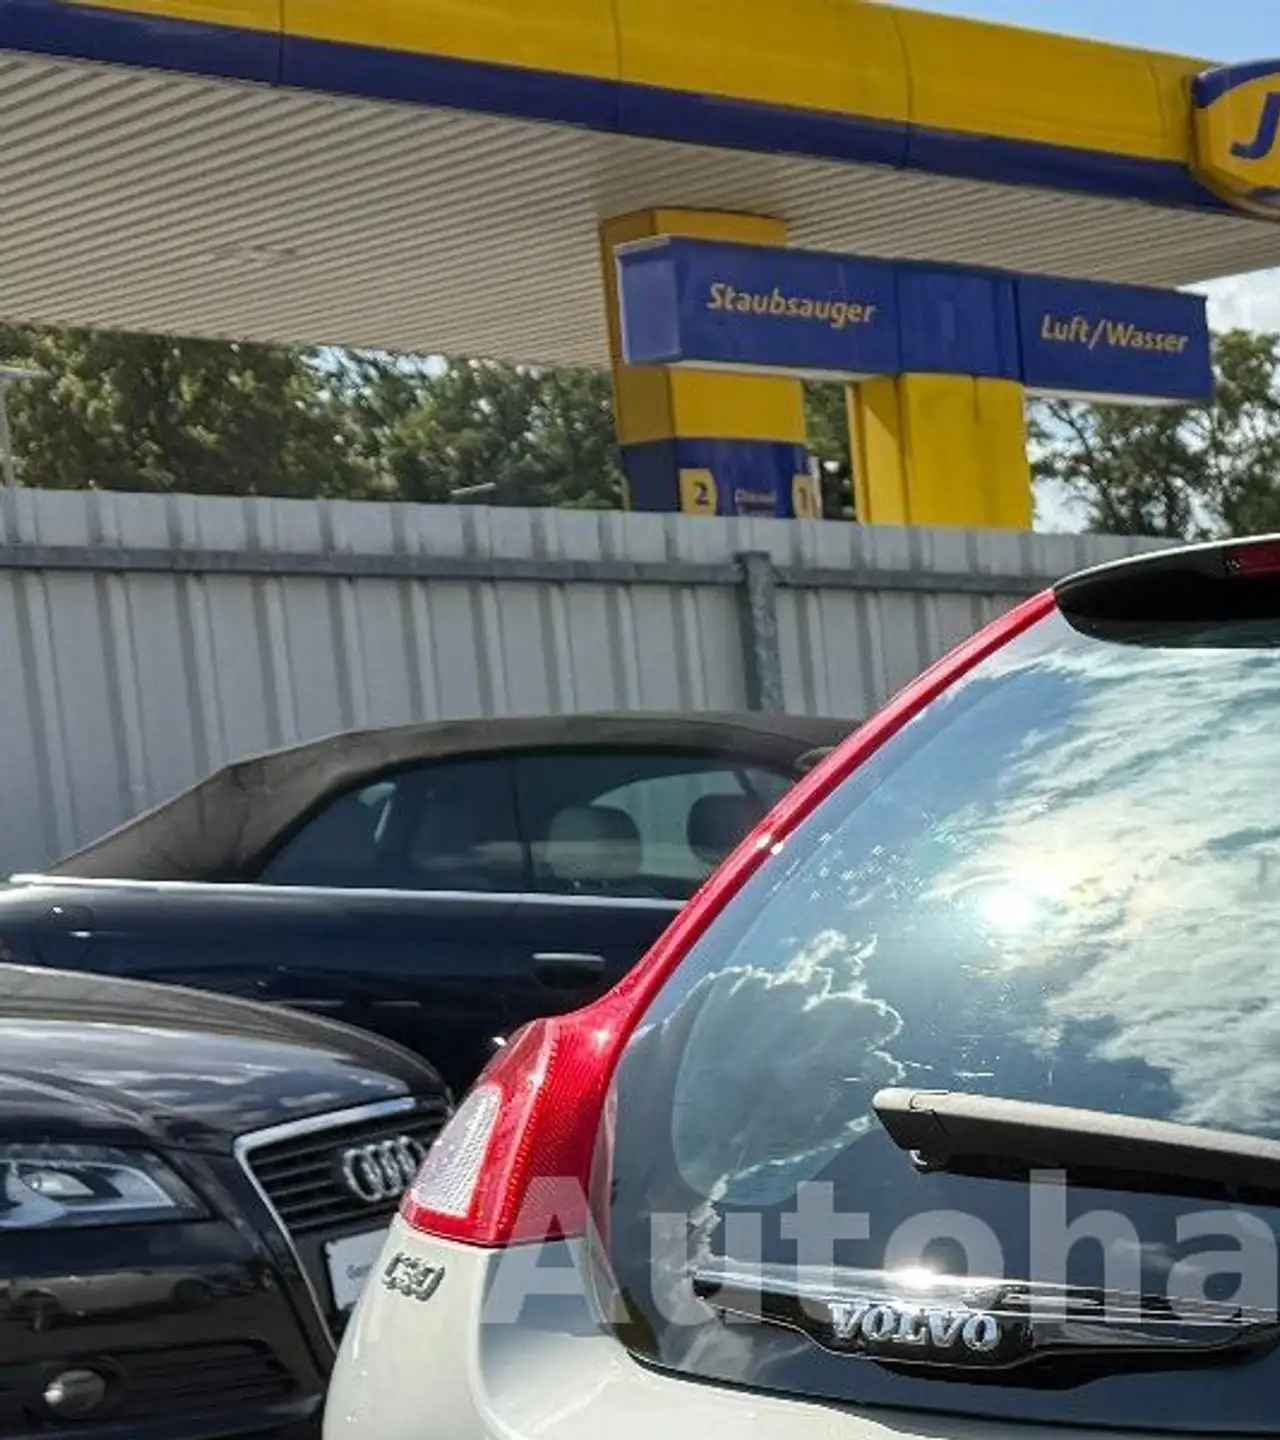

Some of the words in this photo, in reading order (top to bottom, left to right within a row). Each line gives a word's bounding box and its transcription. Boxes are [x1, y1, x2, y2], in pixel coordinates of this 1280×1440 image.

[706, 283, 878, 330] Staubsauger
[1041, 313, 1189, 353] Luft/Wasser
[828, 1300, 1000, 1352] VOLVO
